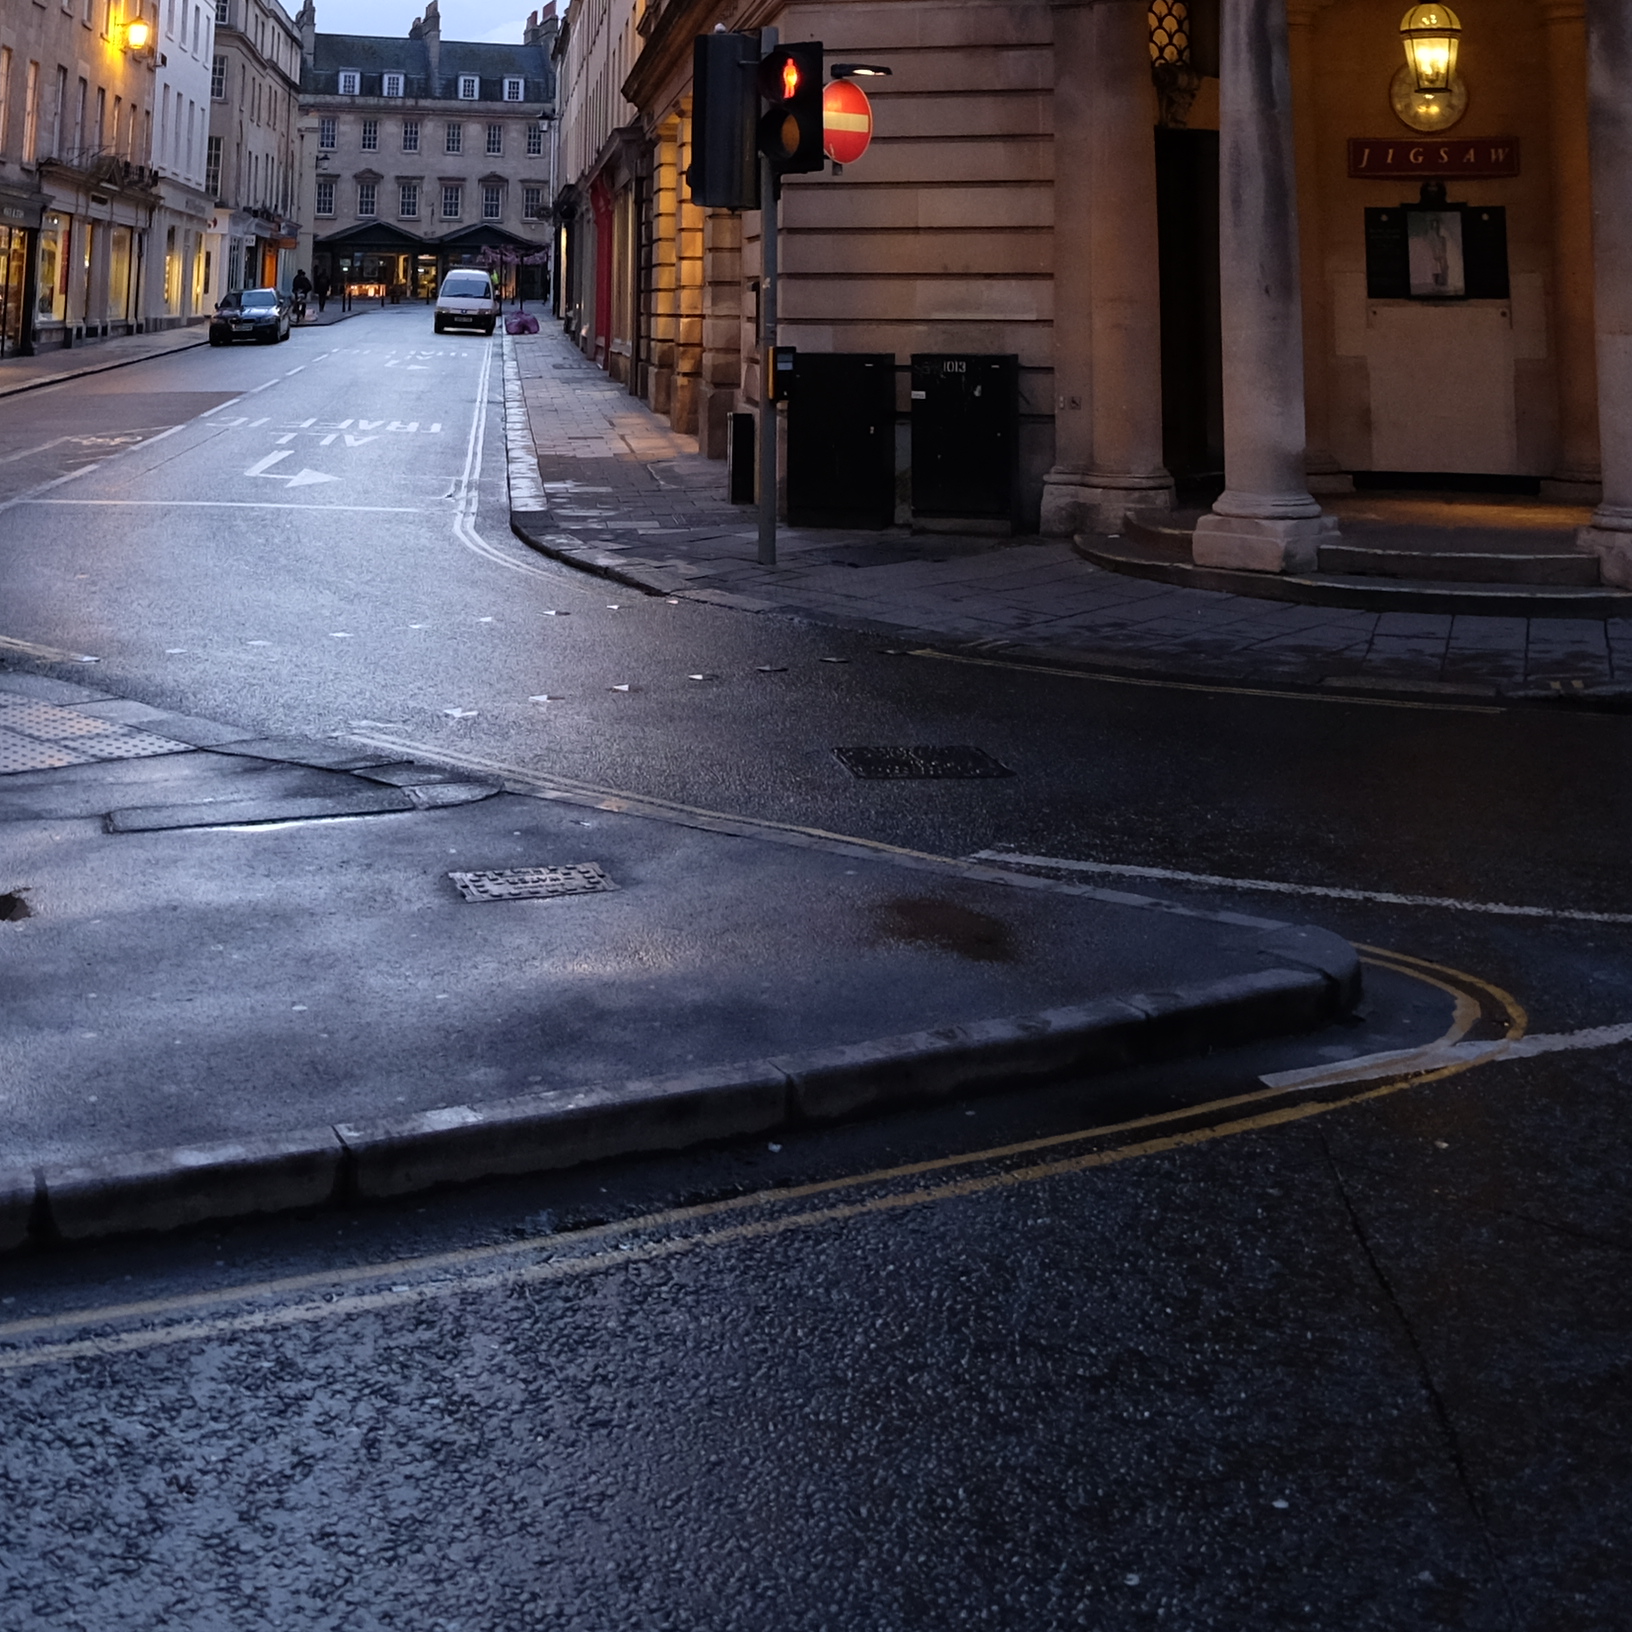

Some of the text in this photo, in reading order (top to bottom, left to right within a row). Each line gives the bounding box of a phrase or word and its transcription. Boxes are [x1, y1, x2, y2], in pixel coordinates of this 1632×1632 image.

[1358, 148, 1510, 168] JIGSAW
[944, 361, 966, 372] 1013
[205, 416, 443, 435] TRAFFIC
